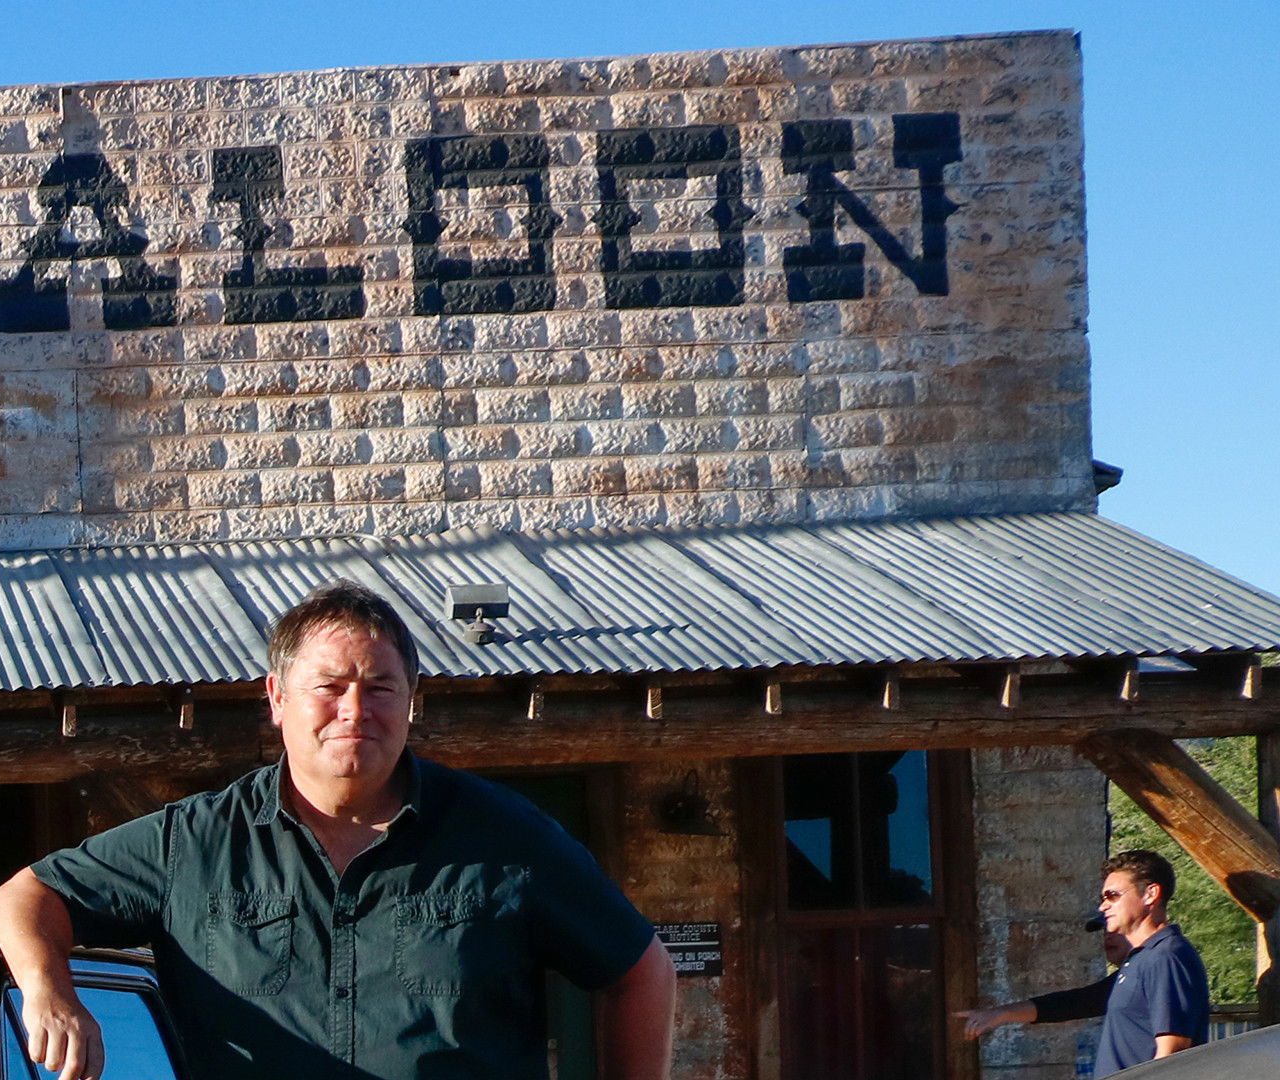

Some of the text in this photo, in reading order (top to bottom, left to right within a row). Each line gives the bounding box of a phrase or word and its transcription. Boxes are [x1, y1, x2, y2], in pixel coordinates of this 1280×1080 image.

[682, 924, 718, 933] COUNTY
[669, 933, 701, 942] NOTICE
[697, 951, 721, 960] PORCH
